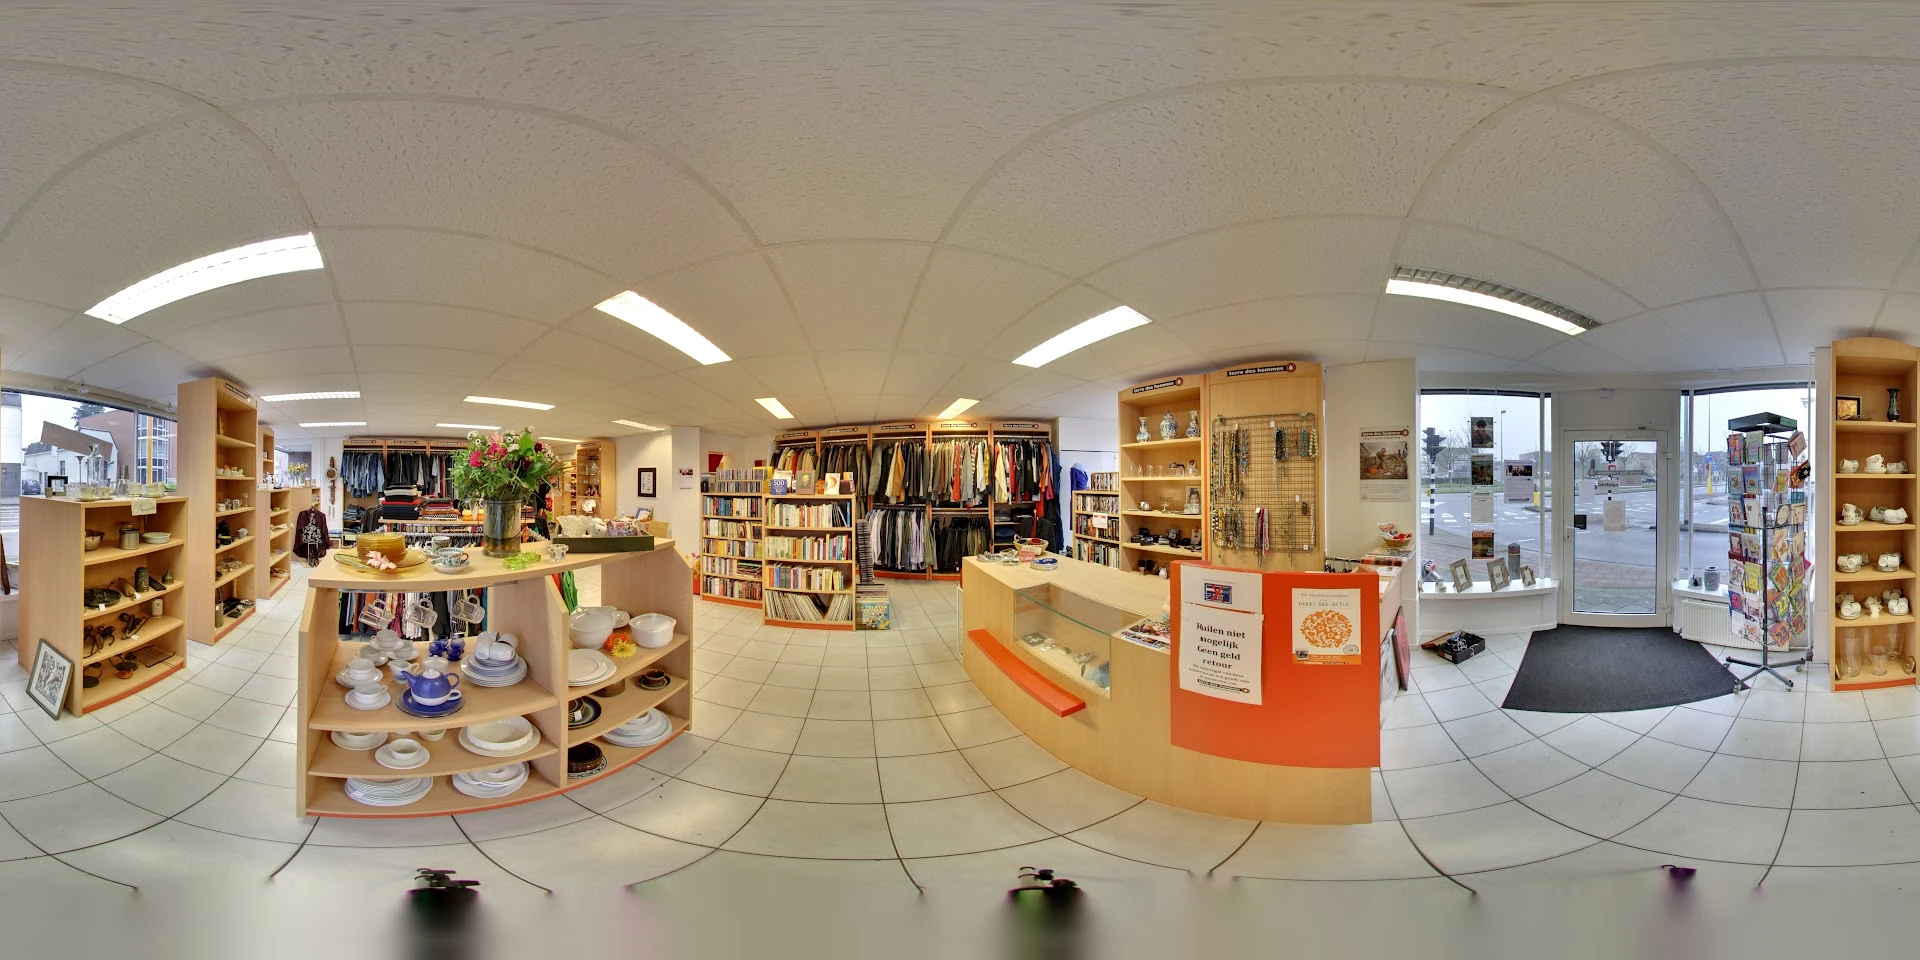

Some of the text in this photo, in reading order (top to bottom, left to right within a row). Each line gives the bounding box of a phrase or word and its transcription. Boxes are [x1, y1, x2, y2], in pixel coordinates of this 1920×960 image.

[1776, 596, 1788, 614] 22
[1197, 622, 1245, 638] Ruilen niet
[1776, 626, 1788, 642] 23
[1200, 636, 1239, 649] mogelijk
[1198, 646, 1218, 656] Geen
[1203, 659, 1232, 669] retour
